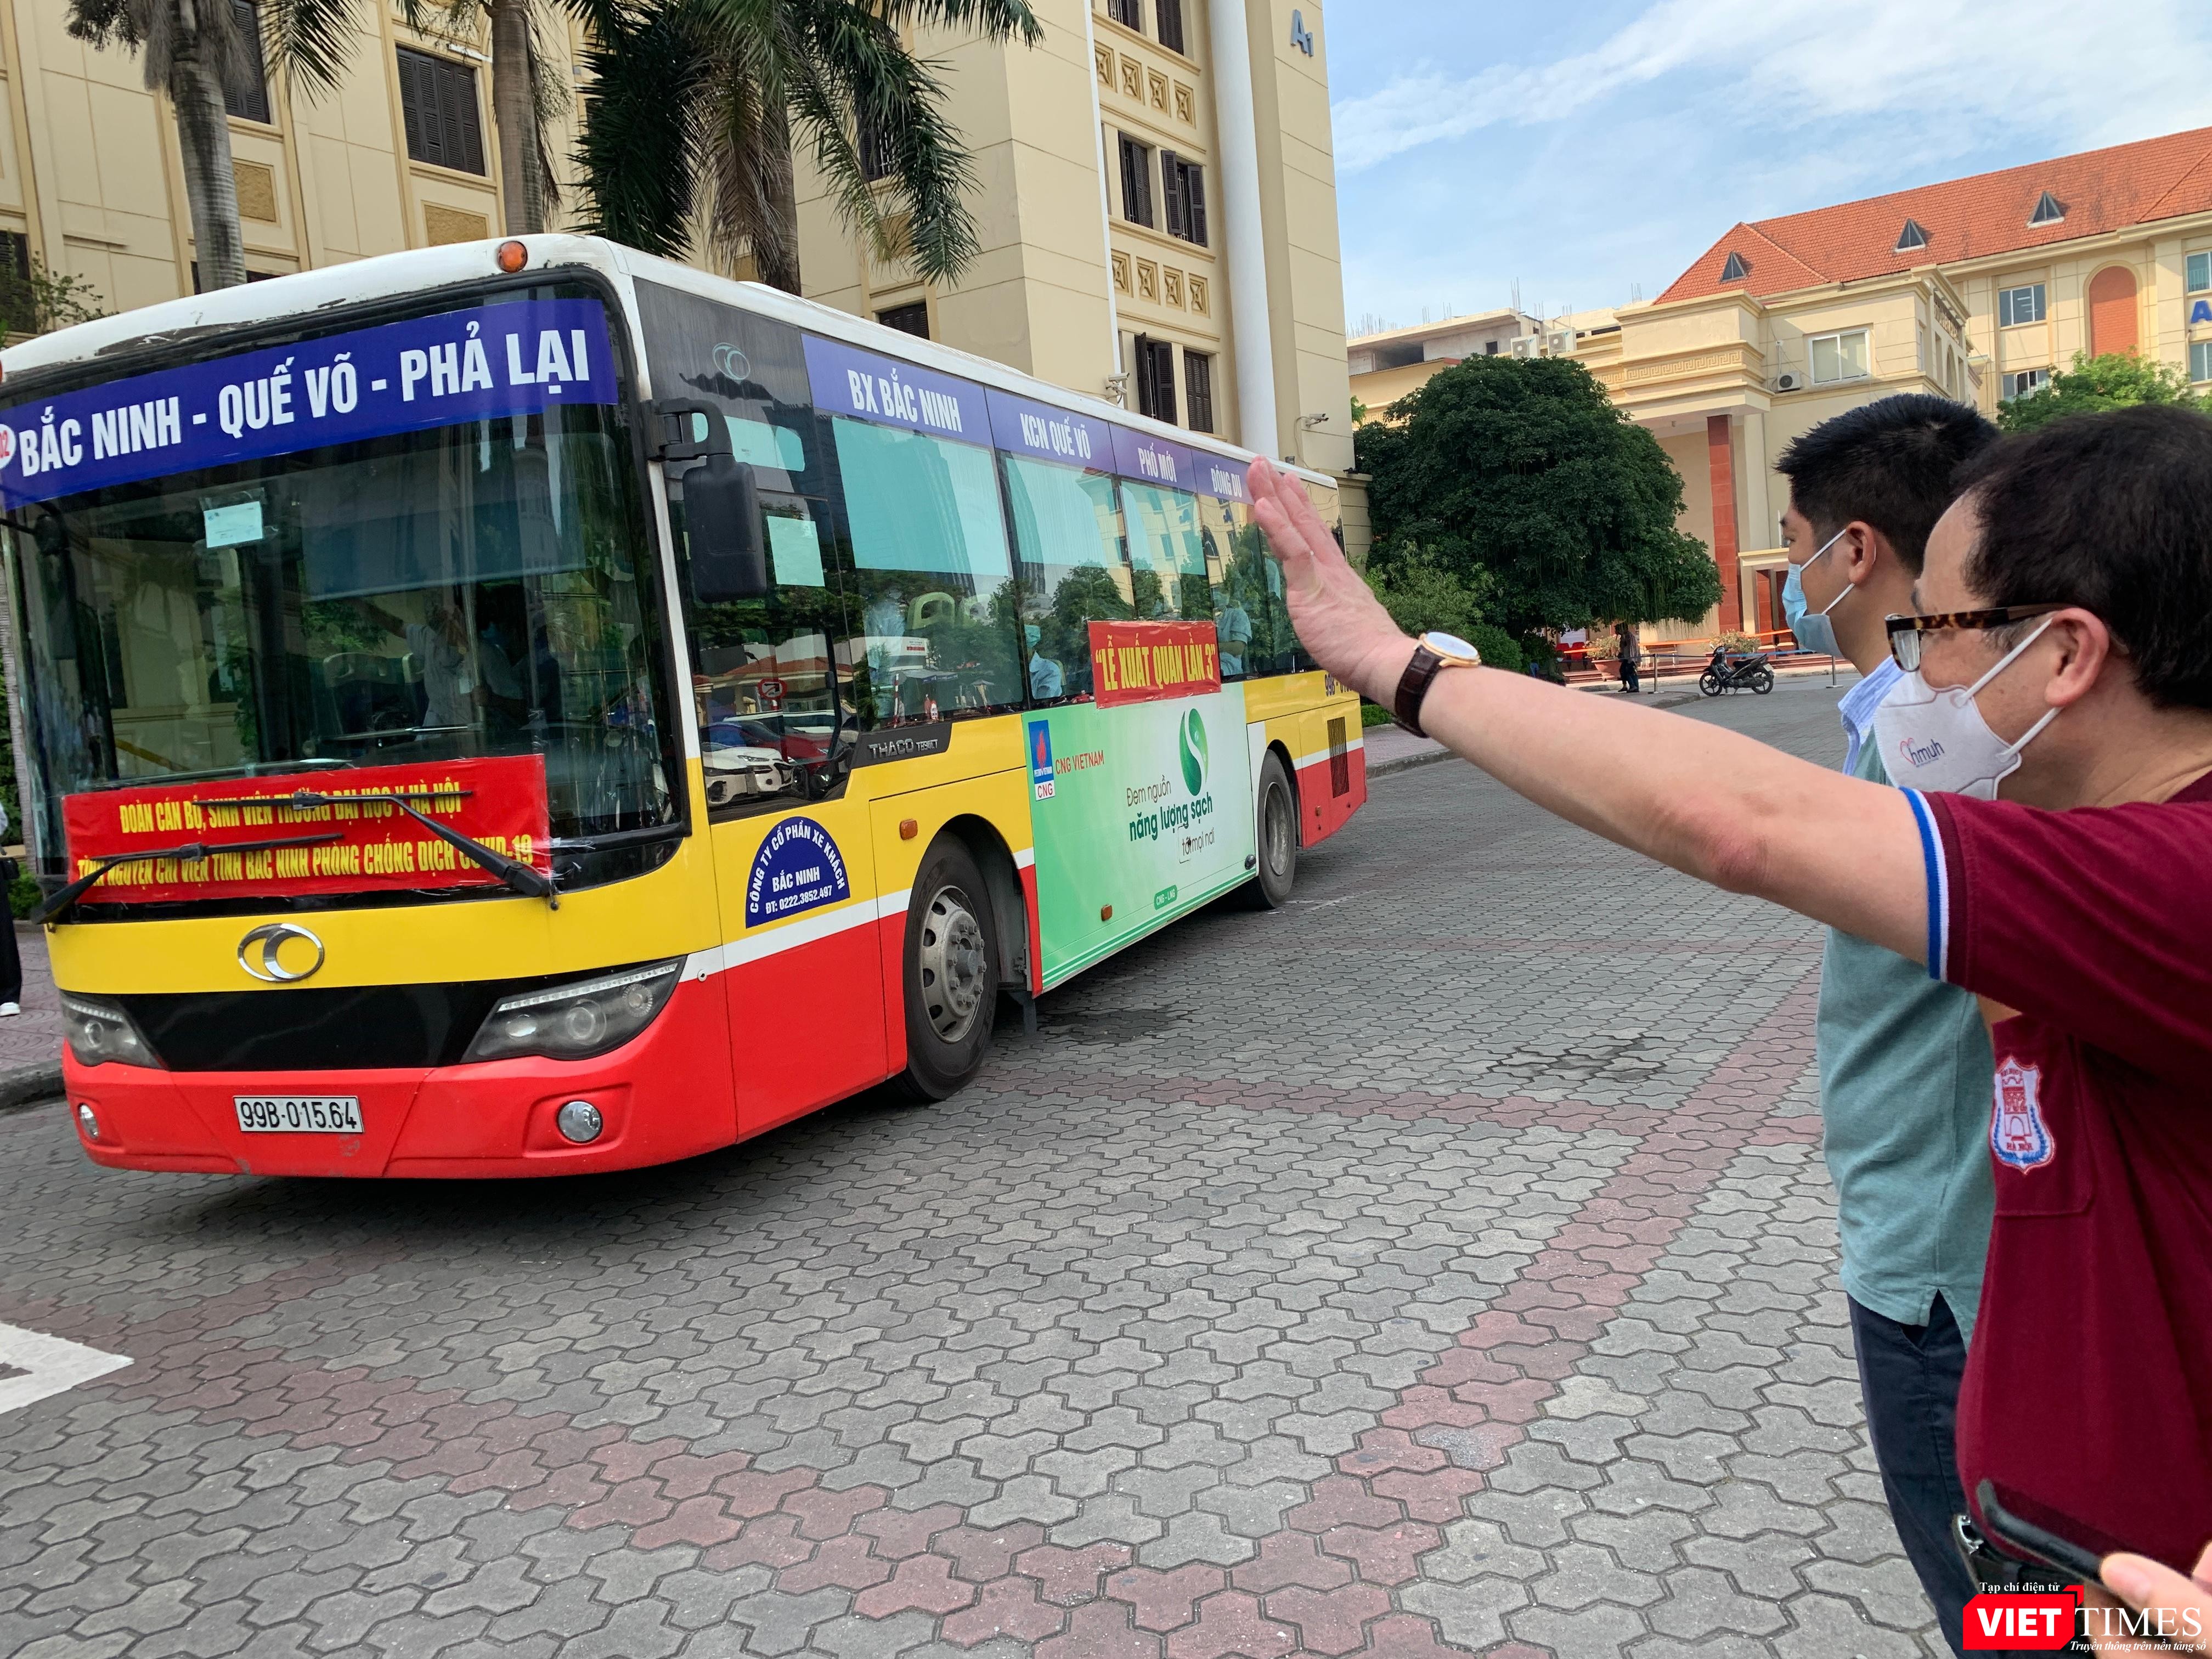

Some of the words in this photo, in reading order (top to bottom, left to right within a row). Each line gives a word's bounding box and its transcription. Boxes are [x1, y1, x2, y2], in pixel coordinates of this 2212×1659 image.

[19, 405, 83, 477] BẮC
[92, 396, 182, 460] NINH
[219, 357, 295, 439] QUẾ
[304, 351, 358, 418] VÕ
[400, 321, 493, 402] PHẢ
[506, 329, 590, 394] LẠI
[847, 369, 879, 414] BX
[878, 367, 918, 422] BẮC
[918, 388, 963, 433] NINH
[1020, 413, 1049, 450] KCN
[1049, 416, 1075, 456] QUẾ
[1073, 424, 1091, 460] VÕ
[1158, 450, 1177, 483] MỚI
[1118, 633, 1150, 690] XUẤT
[1153, 638, 1184, 690] QUÂN
[1184, 632, 1205, 682] LẦN
[868, 738, 913, 758] THACO
[1056, 757, 1071, 775] CNG
[1073, 749, 1104, 771] VIETNAM
[1909, 739, 1944, 765] hmuh
[119, 799, 154, 833] ĐOÀN
[155, 797, 182, 831] CÁN
[433, 776, 461, 819] NỘI
[1037, 783, 1053, 798] CNG
[1127, 787, 1146, 806] Đem
[1148, 775, 1171, 803] nguồn
[1129, 812, 1158, 842] năng
[1160, 804, 1189, 833] lượng
[1191, 792, 1212, 824] sạch
[276, 848, 310, 878] NINH
[312, 841, 360, 877] PHÒNG
[364, 833, 415, 874] CHỐNG
[417, 840, 455, 877] DỊCH
[1192, 831, 1204, 853] mọi
[749, 867, 765, 913] CÔNG
[760, 845, 772, 867] TY
[771, 826, 785, 851] CỔ
[785, 820, 811, 840] PHẦN
[812, 829, 825, 848] XE
[823, 842, 845, 890] KHÁCH
[772, 870, 794, 893] BẮC
[795, 866, 820, 886] NINH
[765, 900, 778, 915] ĐT:
[779, 885, 833, 910] 0222.3852.497
